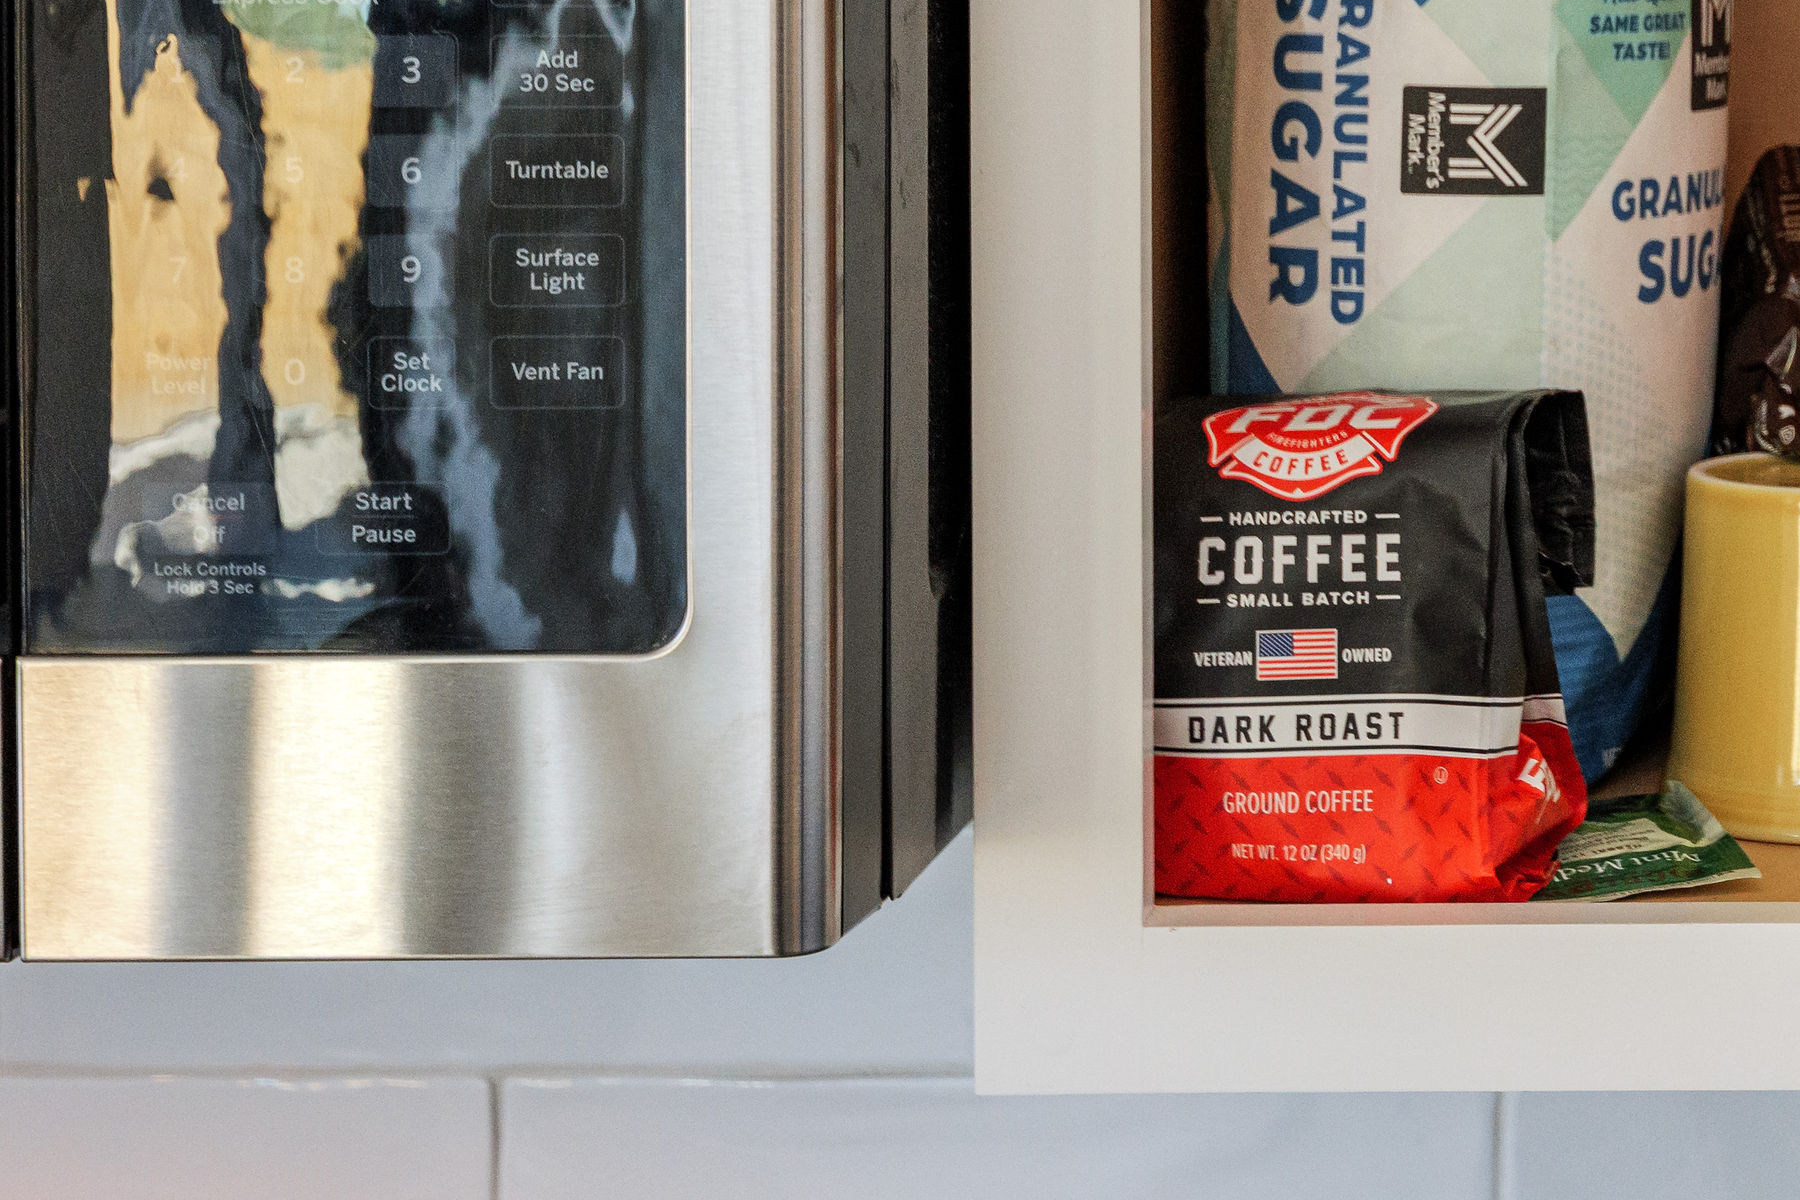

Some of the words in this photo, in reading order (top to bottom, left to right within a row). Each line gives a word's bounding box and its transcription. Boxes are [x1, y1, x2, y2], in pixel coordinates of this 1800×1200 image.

[1589, 13, 1640, 35] SAME
[1643, 12, 1686, 32] GREAT
[285, 57, 305, 83] 2
[401, 57, 422, 83] 3
[535, 49, 578, 70] Add
[519, 72, 546, 93] 30
[552, 72, 595, 93] Sec
[1407, 113, 1423, 167] Mark
[1425, 91, 1447, 190] Member's
[285, 157, 304, 183] 5
[401, 157, 422, 184] 6
[506, 160, 610, 181] Turntable
[516, 247, 601, 268] Surface
[1638, 229, 1722, 305] SUG
[168, 257, 189, 282] 7
[284, 256, 306, 283] 8
[401, 256, 422, 283] 9
[529, 269, 586, 295] Light
[146, 354, 210, 374] Power
[284, 358, 306, 386] 0
[393, 352, 431, 371] Set
[511, 361, 561, 382] Vent
[567, 361, 604, 382] Fan
[151, 375, 207, 395] Level
[381, 373, 443, 393] Clock
[1225, 402, 1415, 434] FDC
[1252, 448, 1350, 476] COFFEE
[172, 492, 246, 513] Cancel
[355, 492, 413, 512] Start
[1228, 509, 1369, 528] HANDCRAFTED
[192, 524, 226, 545] Off
[351, 525, 417, 544] Pause
[154, 562, 192, 577] Lock
[197, 562, 267, 577] Controls
[1198, 532, 1402, 586] COFFEE
[166, 579, 204, 595] Hold
[208, 580, 220, 595] 3
[224, 579, 255, 595] Sec
[1226, 592, 1293, 608] SMALL
[1301, 590, 1371, 607] BATCH
[1193, 650, 1254, 668] VETERAN
[1341, 646, 1393, 664] OWNED
[1187, 712, 1276, 745] DARK
[1296, 711, 1405, 742] ROAST
[1222, 791, 1300, 815] GROUND
[1304, 789, 1375, 814] COFFEE
[1231, 842, 1255, 861] NET
[1257, 842, 1280, 862] WT.
[1282, 842, 1297, 862] 12
[1300, 842, 1319, 862] OZ
[1321, 841, 1350, 864] (340
[1353, 843, 1367, 865] g)
[1628, 849, 1704, 866] Mint
